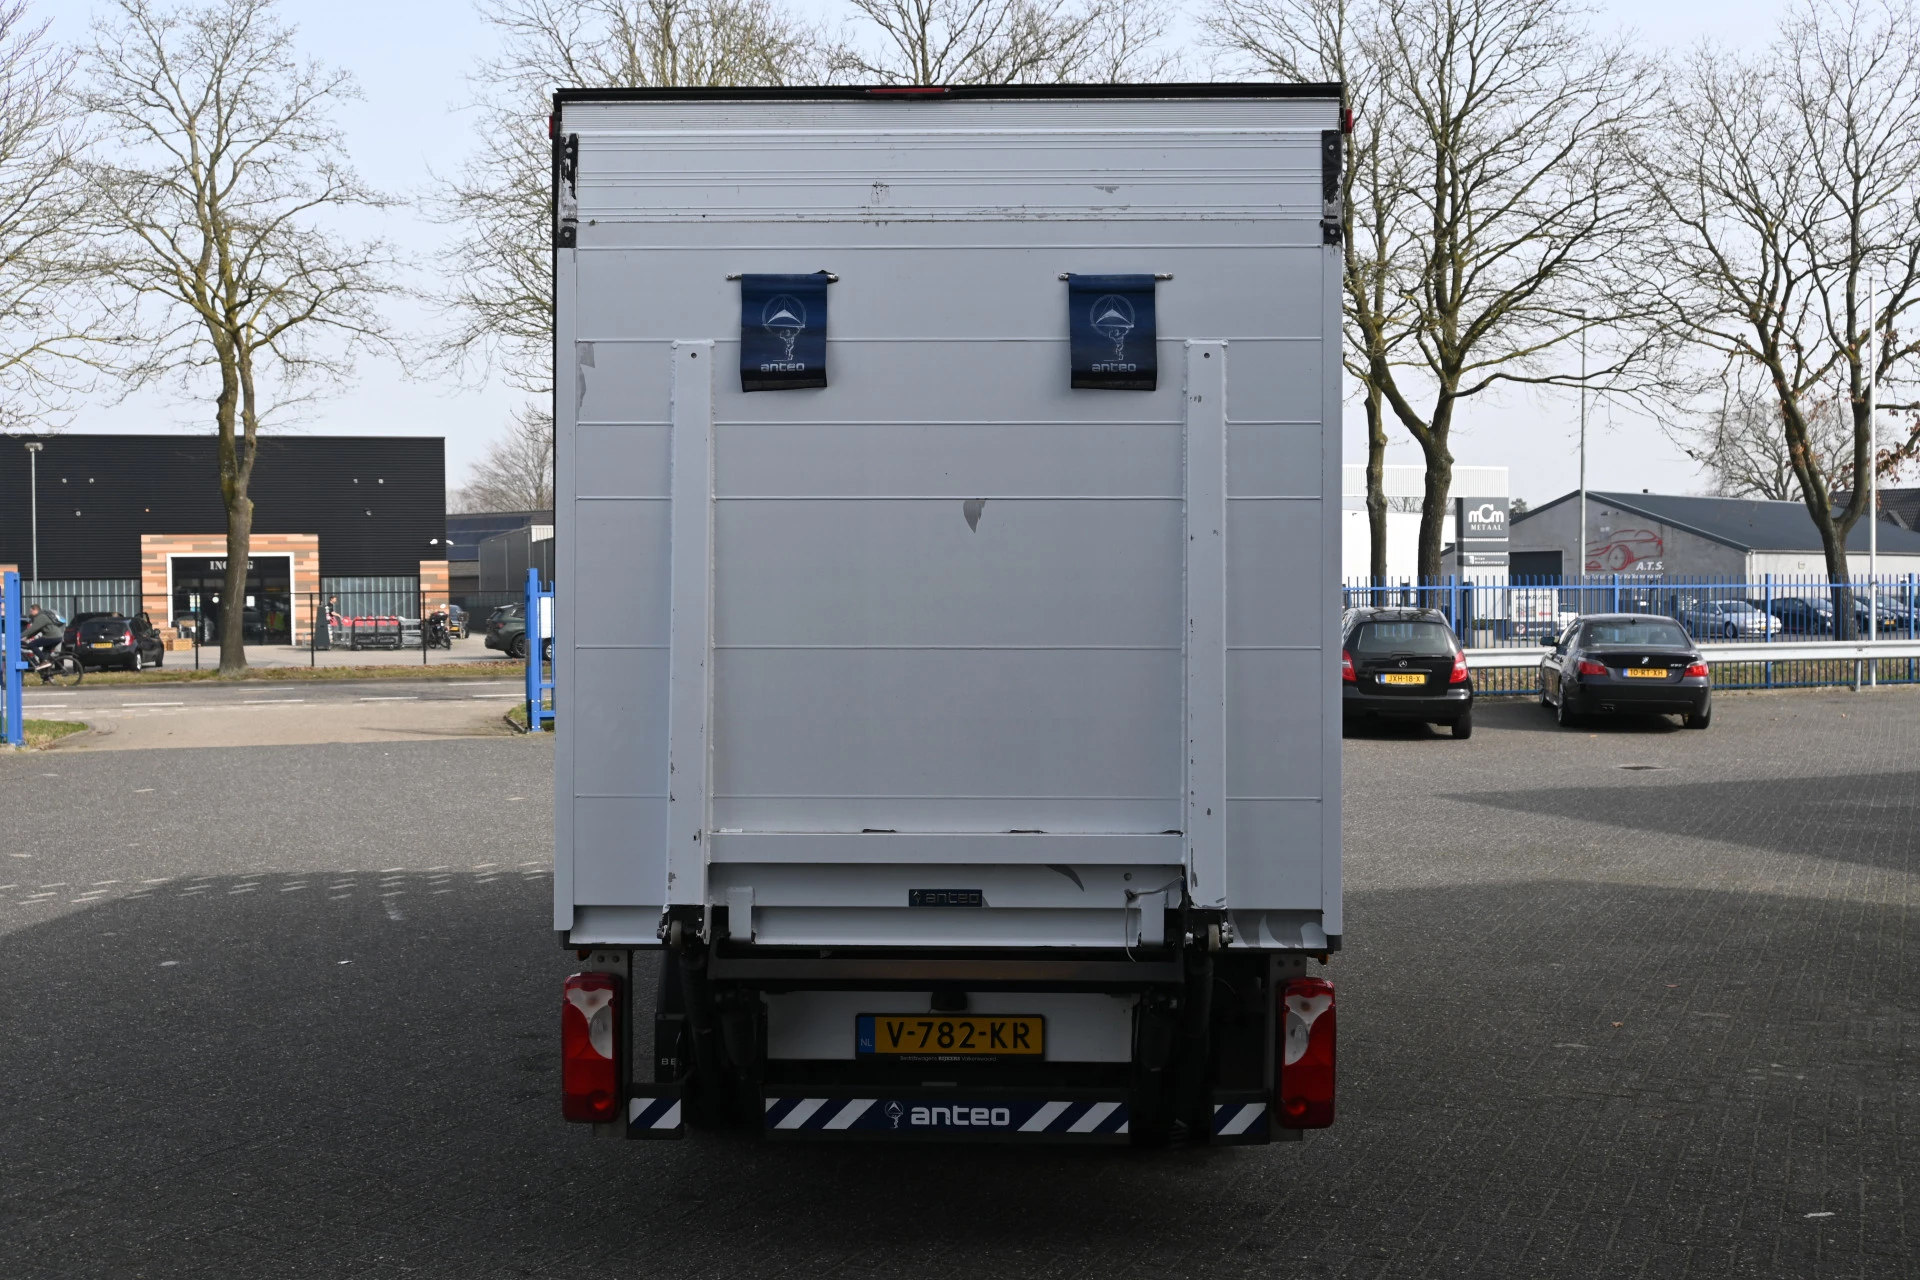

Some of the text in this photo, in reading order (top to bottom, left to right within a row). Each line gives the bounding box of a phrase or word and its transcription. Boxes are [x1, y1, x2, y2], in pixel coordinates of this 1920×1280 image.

[761, 362, 805, 372] anteo
[1091, 362, 1137, 372] anteo
[1470, 523, 1503, 531] METAAL
[1635, 561, 1665, 571] A.T.S.
[1629, 668, 1663, 677] 10-RT-XH
[925, 892, 980, 904] anteo
[860, 1021, 1031, 1049] NL V-782-KR
[911, 1105, 1010, 1126] anteo
